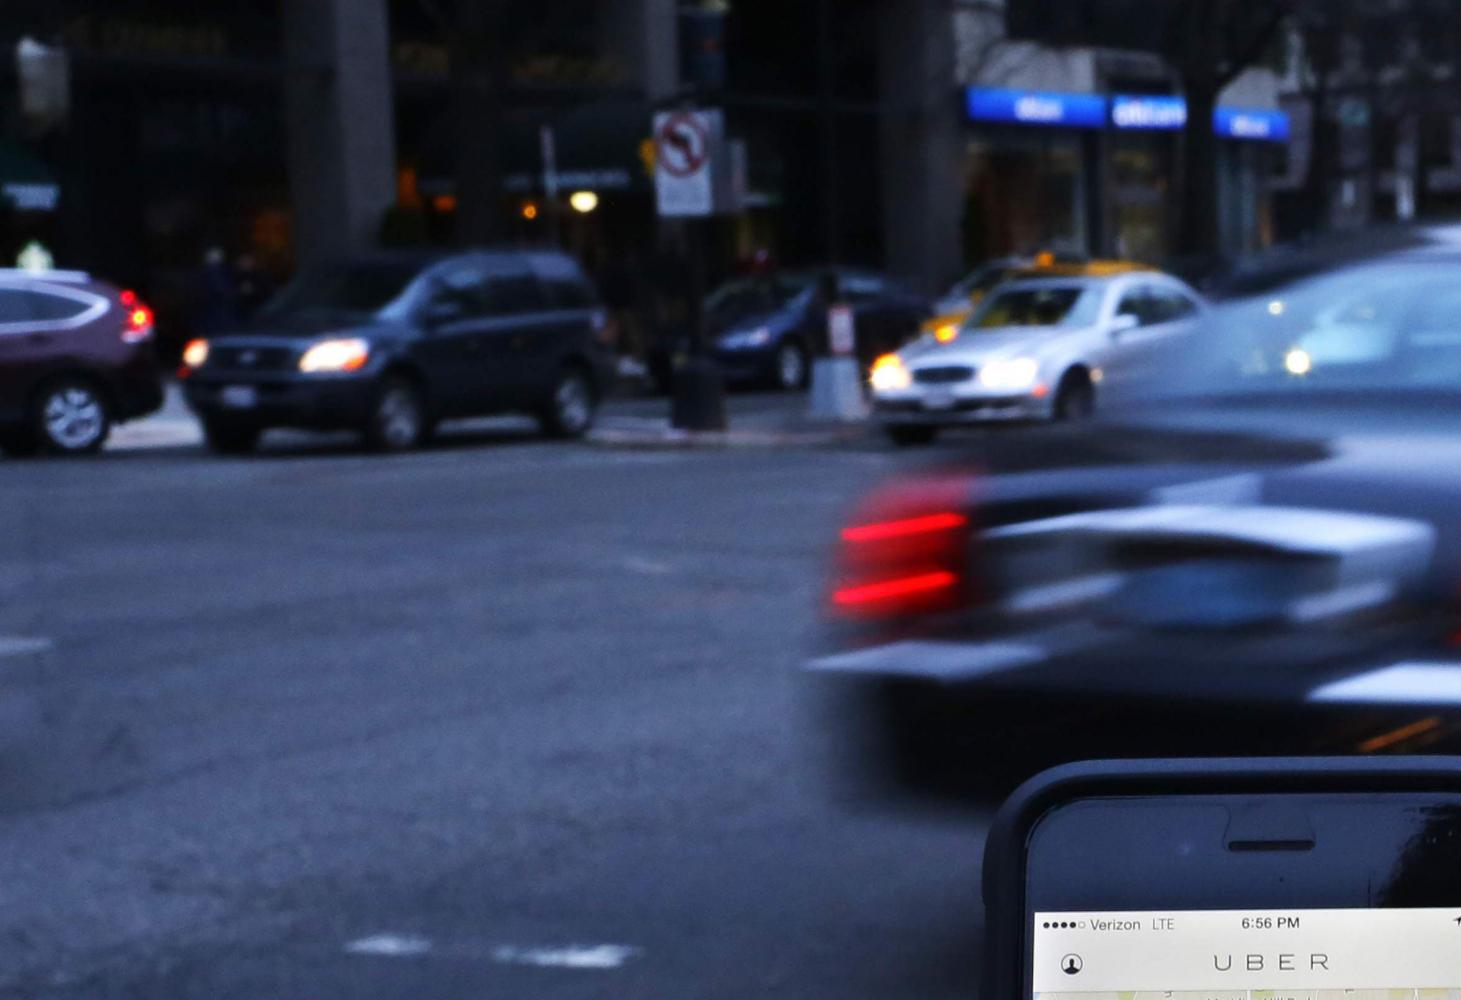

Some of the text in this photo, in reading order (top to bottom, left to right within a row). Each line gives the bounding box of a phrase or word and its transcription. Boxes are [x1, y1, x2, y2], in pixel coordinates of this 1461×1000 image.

[1090, 918, 1175, 931] Verizon LTE
[1242, 917, 1300, 929] 6:56 PM
[1214, 953, 1329, 971] UBER
